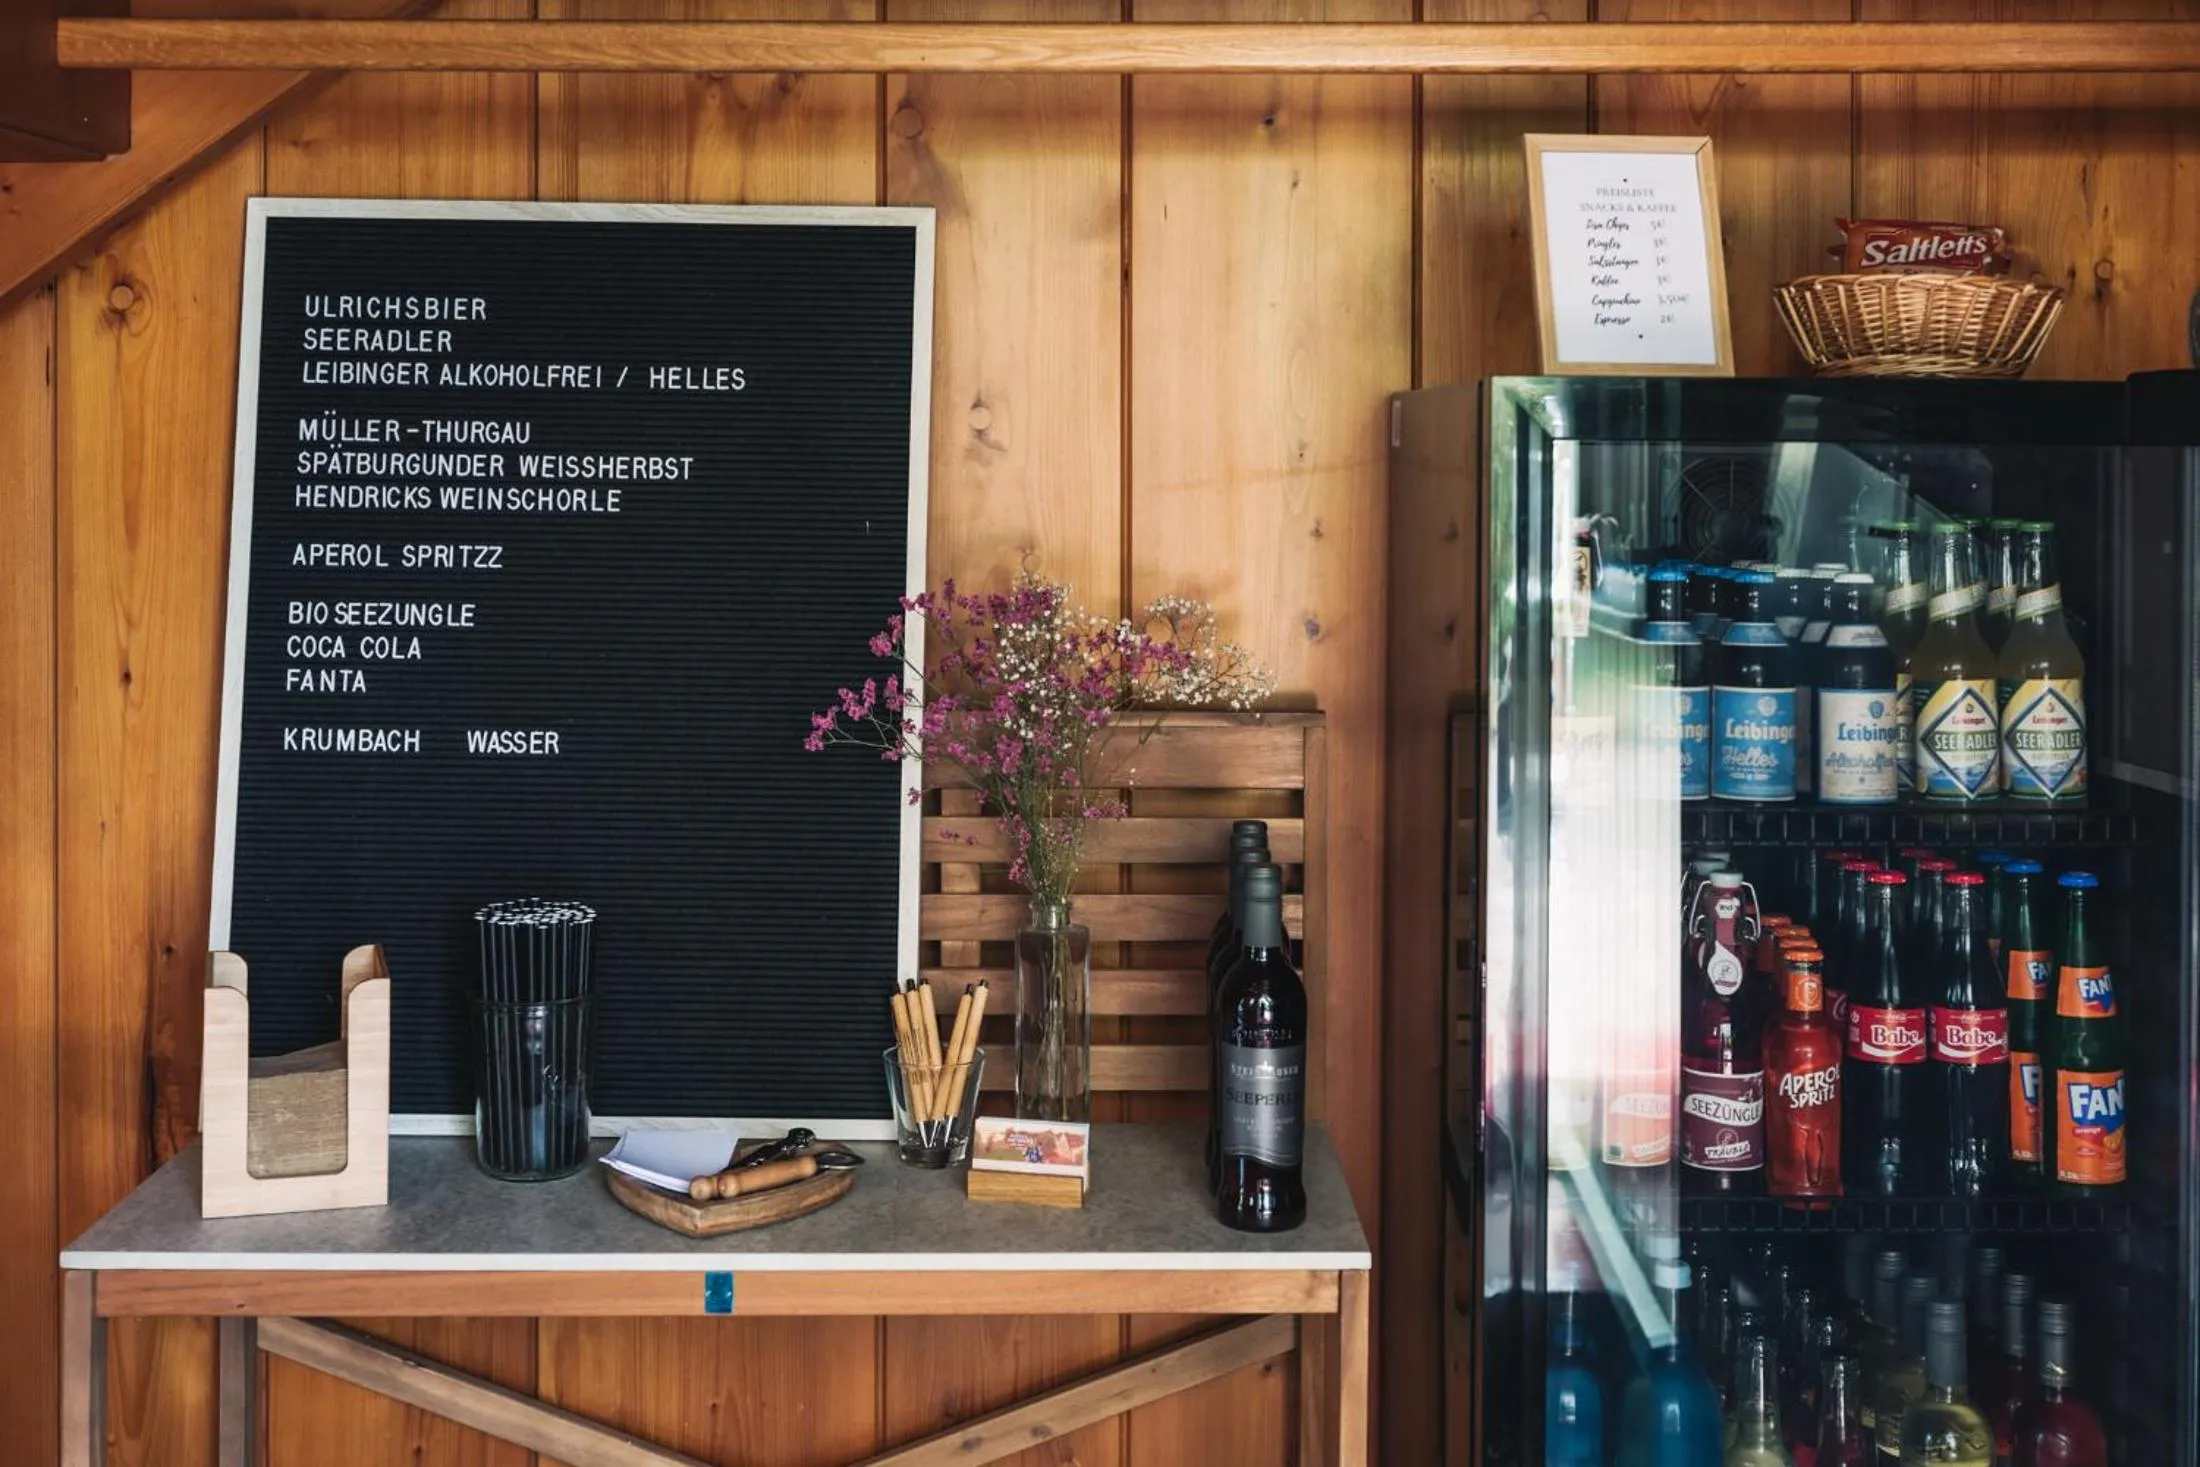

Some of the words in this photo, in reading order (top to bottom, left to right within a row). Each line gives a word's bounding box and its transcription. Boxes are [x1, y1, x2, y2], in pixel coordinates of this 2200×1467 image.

[1861, 235, 1988, 267] Saltletts
[305, 295, 487, 321] ULRICHSBIER
[303, 327, 452, 353] SEERADLER
[302, 361, 429, 386] LEIBINGER
[439, 363, 602, 388] ALKOHOLFREI
[616, 366, 629, 388] /
[649, 366, 746, 391] HELLES
[298, 409, 531, 444] MÜLLER-THURGAU
[296, 442, 505, 477] SPÄTBURGUNDER
[519, 454, 694, 481] WEISSHERBST
[295, 484, 432, 509] HENDRICKS
[439, 486, 622, 513] WEINSCHORLE
[292, 542, 389, 567] APEROL
[401, 543, 503, 569] SPRITZZ
[288, 601, 329, 625] BIO
[333, 601, 476, 627] SEEZUNGLE
[286, 634, 346, 660] COCA
[359, 635, 422, 660] COLA
[286, 668, 367, 694] FANTA
[283, 727, 421, 753] KRUMBACH
[467, 730, 560, 755] WASSER
[1871, 1024, 1919, 1046] Babe
[1946, 1025, 1996, 1046] Babe
[1789, 1084, 1836, 1109] SPRITZ
